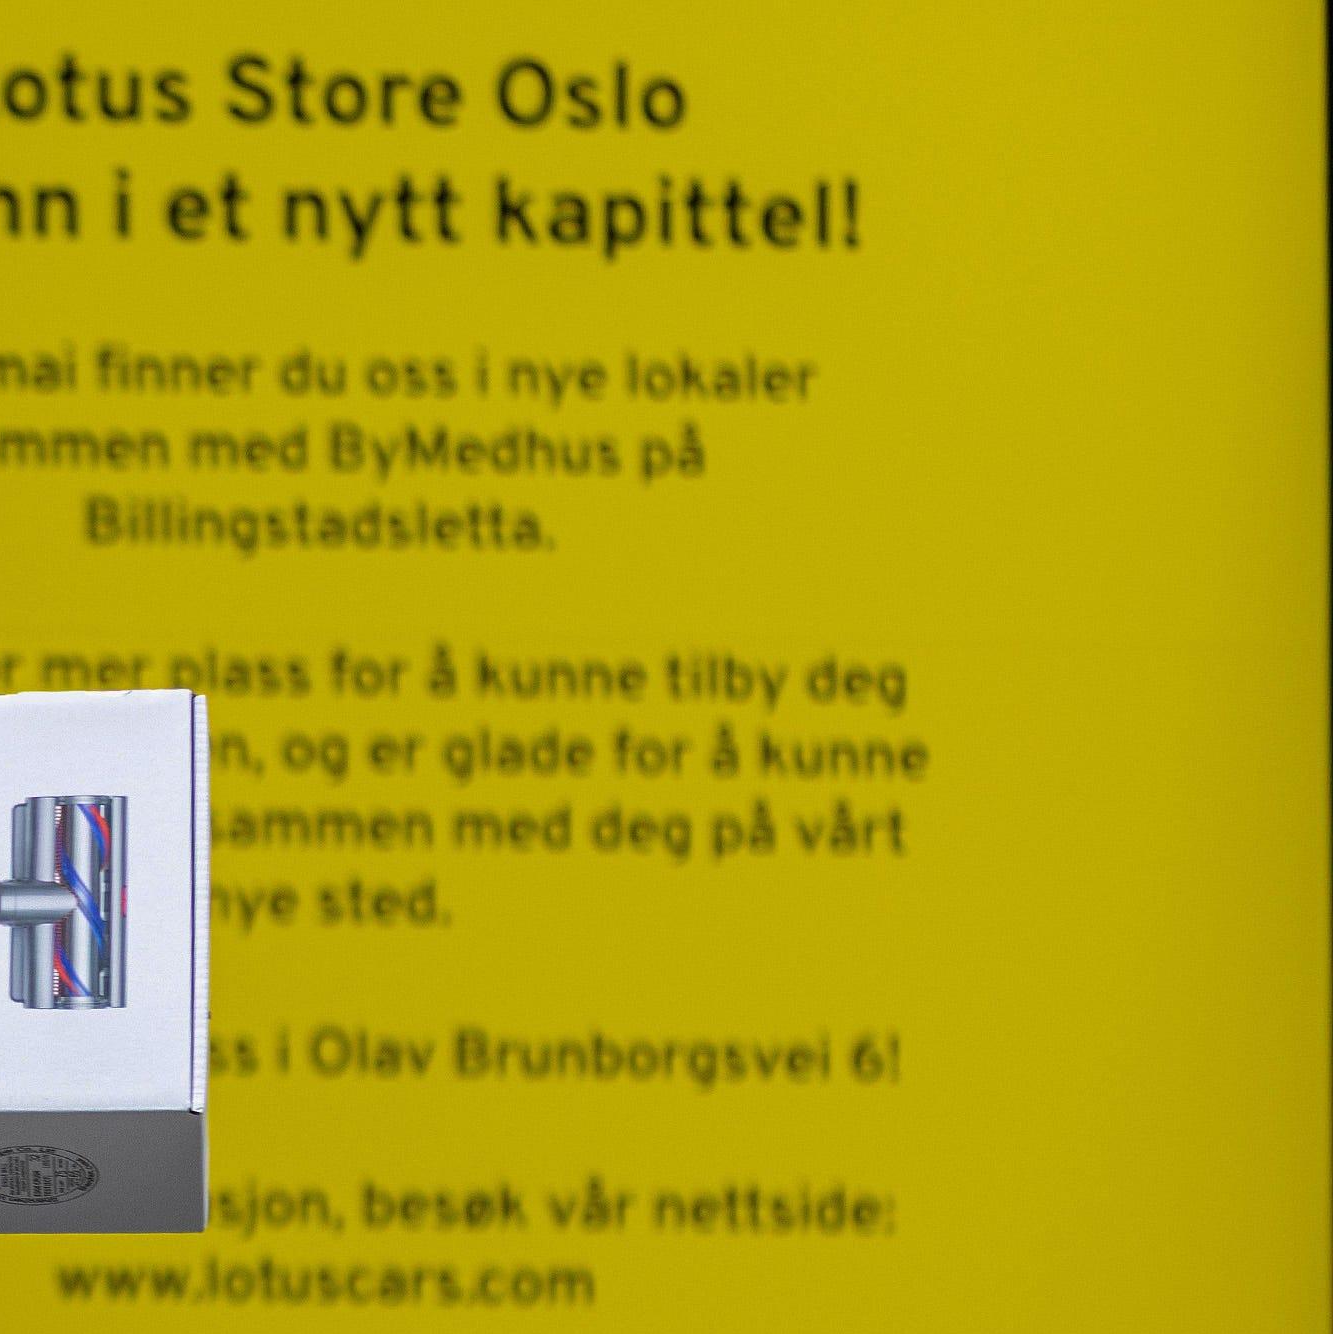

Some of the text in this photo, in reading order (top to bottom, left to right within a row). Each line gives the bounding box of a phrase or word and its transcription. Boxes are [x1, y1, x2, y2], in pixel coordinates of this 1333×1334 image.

[224, 51, 465, 130] Store
[493, 54, 689, 133] Oslo
[113, 167, 132, 240] i
[162, 171, 249, 244] et
[281, 173, 461, 261] nytt
[493, 174, 861, 262] kapittel!
[93, 341, 260, 397] finner
[276, 346, 349, 399] du
[363, 356, 460, 400] oss
[474, 351, 491, 396] i
[506, 357, 610, 409] nye
[624, 351, 818, 404] lokaler
[186, 423, 311, 475] med
[326, 419, 623, 483] ByMedhus
[638, 419, 708, 485] på
[81, 492, 555, 560] Billingstadsletta.
[40, 650, 148, 692] mer
[168, 645, 313, 698] plass
[328, 645, 409, 700] for
[425, 638, 460, 701] å
[473, 650, 649, 703] kunne
[663, 652, 789, 713] tilby
[803, 654, 909, 717] deg
[279, 731, 351, 786] og
[365, 733, 424, 776] er
[440, 725, 597, 787] glade
[611, 724, 691, 779] for
[708, 719, 742, 780] å
[755, 729, 931, 783] kunne
[450, 802, 574, 854] med
[588, 803, 694, 865] deg
[708, 795, 779, 863] på
[793, 796, 906, 858] vårt
[316, 876, 452, 930] sted.
[274, 1025, 292, 1075] i
[306, 1023, 436, 1080] Olav
[450, 1024, 833, 1093] Brunborgsvei
[847, 1030, 902, 1085] 6!
[217, 1173, 894, 1237] sjon, besøk vår nettside:
[53, 1254, 597, 1308] www.lotuscars.com
